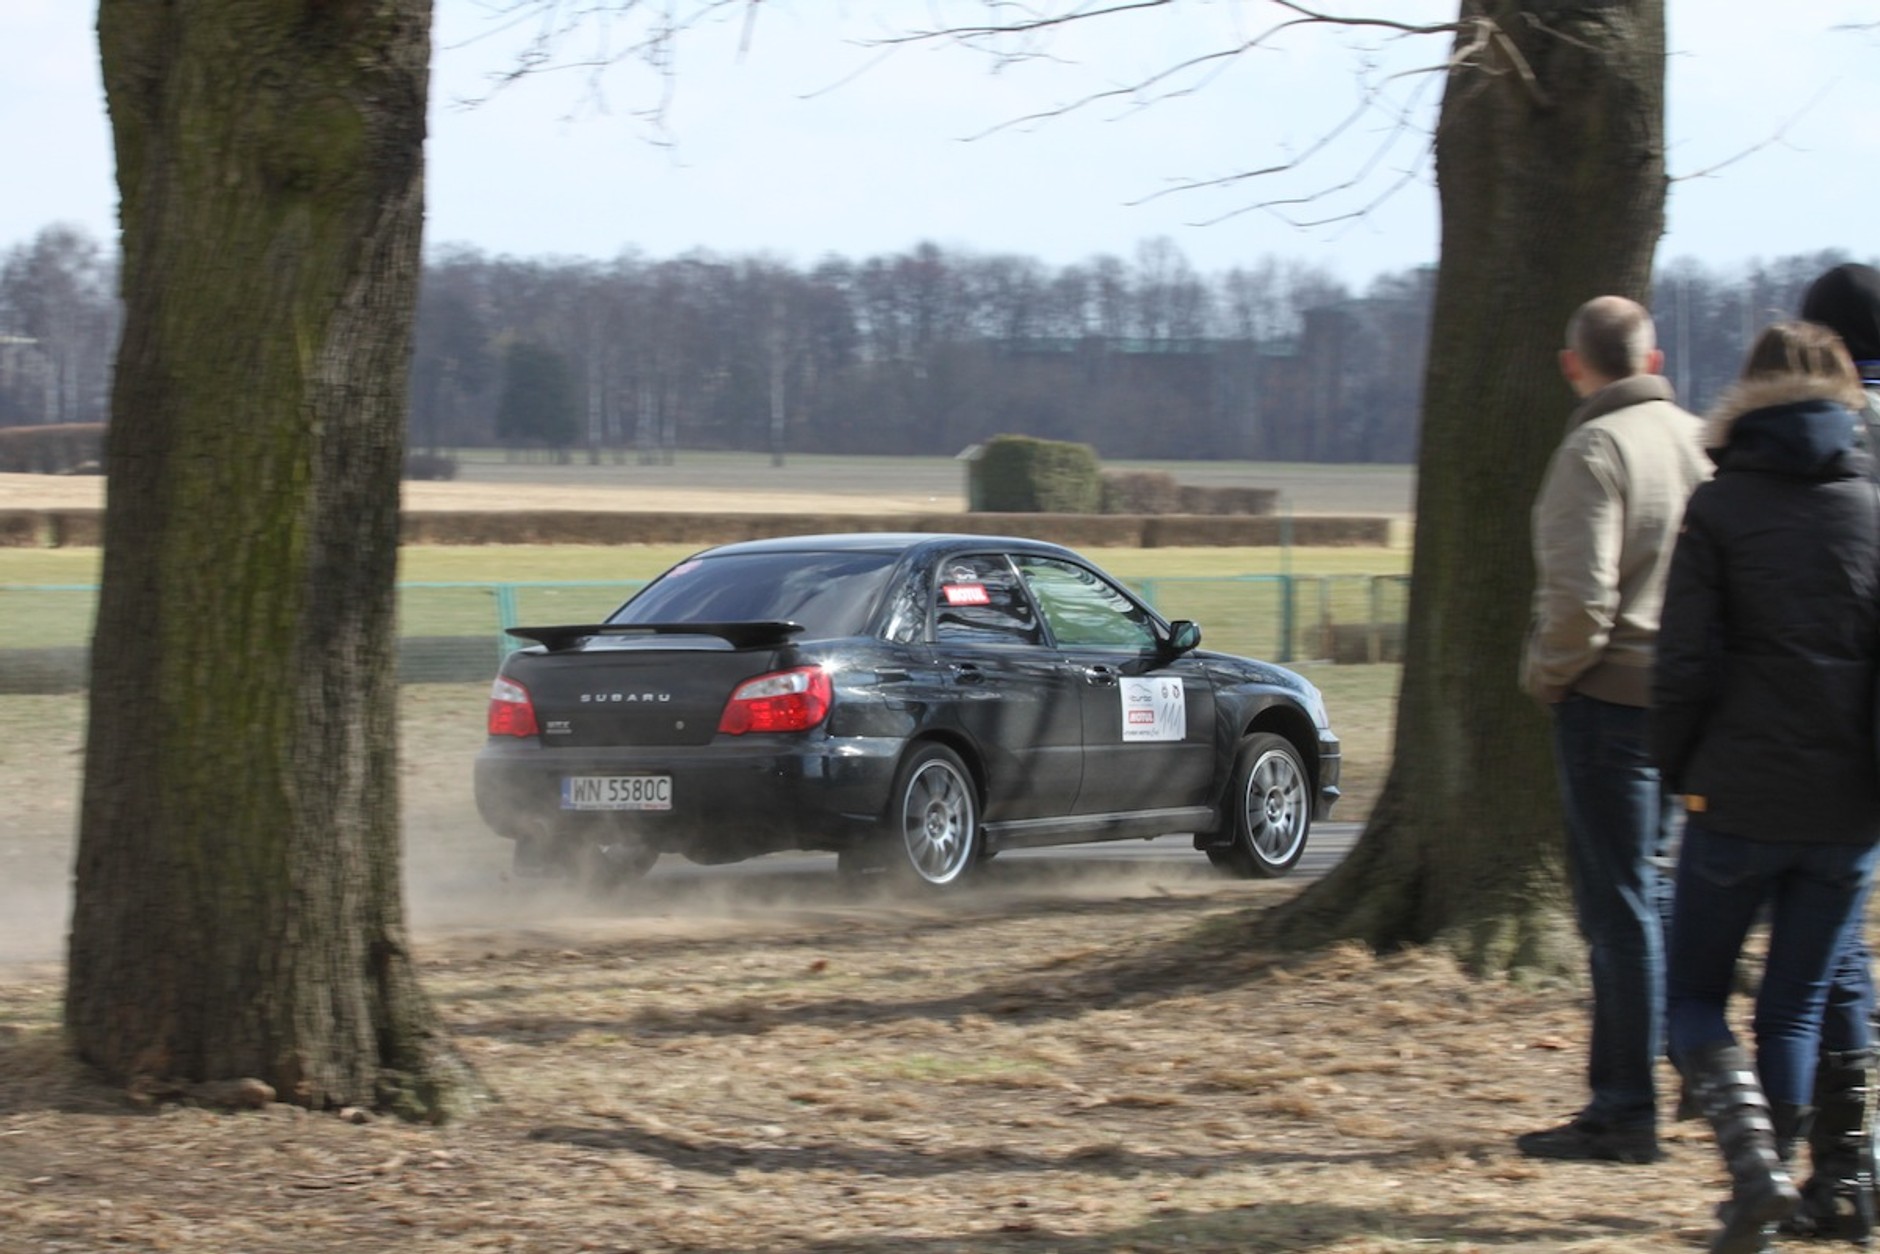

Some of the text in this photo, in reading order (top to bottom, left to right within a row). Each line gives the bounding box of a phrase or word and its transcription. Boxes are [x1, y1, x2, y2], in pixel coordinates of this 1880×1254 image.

[580, 693, 670, 702] SUBARU
[574, 779, 668, 802] WN 5580C
